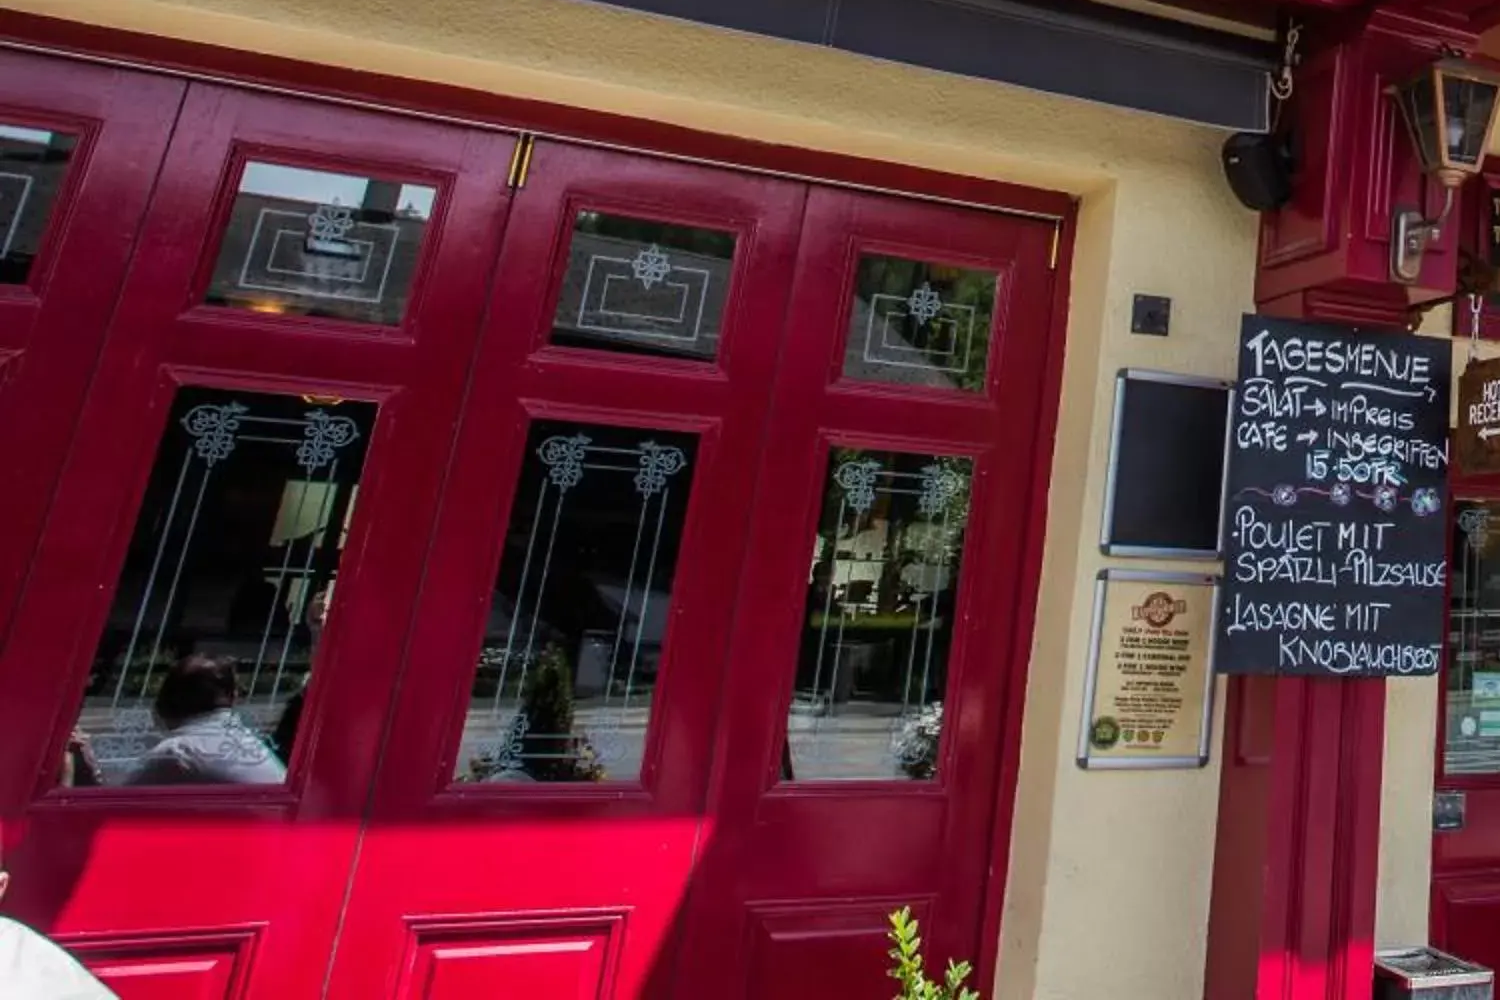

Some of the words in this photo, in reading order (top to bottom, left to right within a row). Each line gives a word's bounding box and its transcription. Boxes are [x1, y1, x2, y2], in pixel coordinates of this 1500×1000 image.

[1246, 328, 1432, 384] TAGESMENUE
[1241, 384, 1309, 419] SALAT
[1330, 399, 1348, 423] IM
[1349, 394, 1415, 430] PREIS
[1237, 420, 1288, 452] CAFE
[1327, 427, 1450, 469] INBEGRIFFEN
[1234, 504, 1331, 553] POULET
[1337, 521, 1397, 551] MIT
[1344, 602, 1392, 632] MIT
